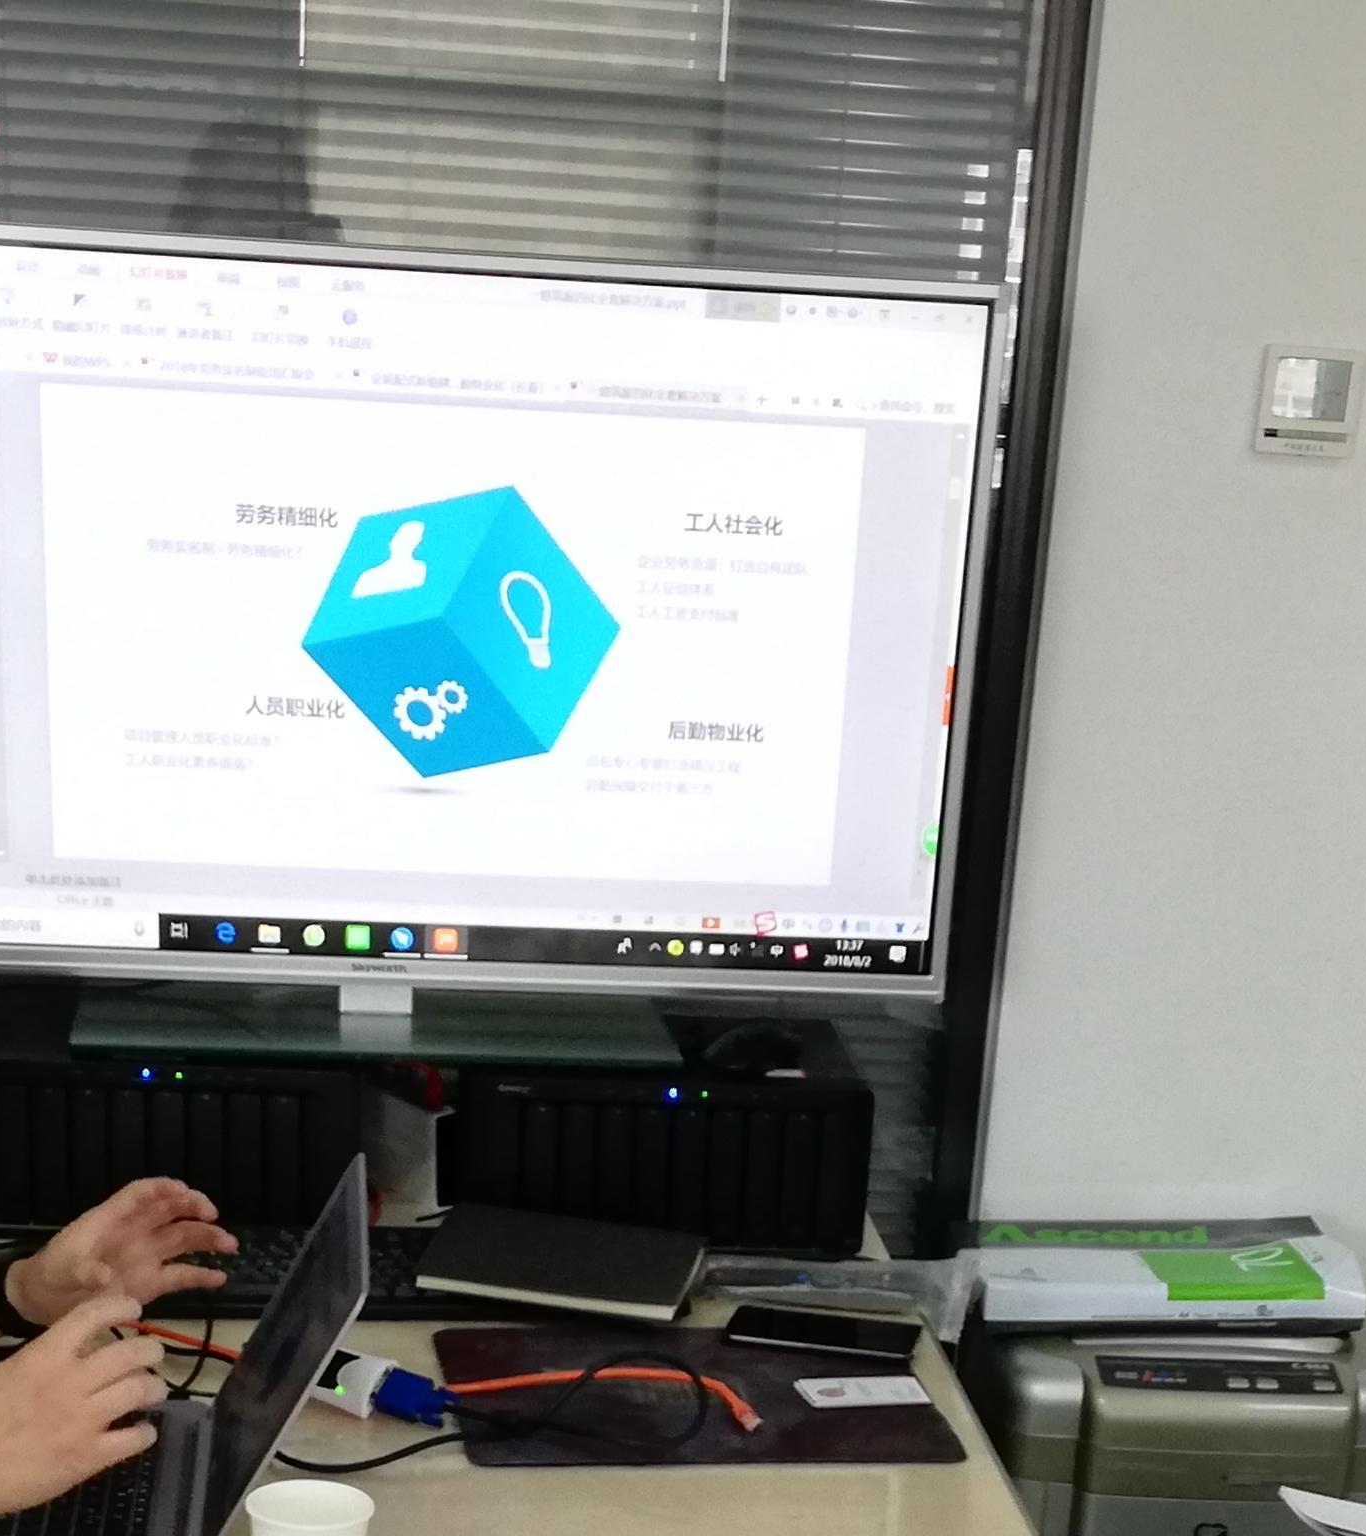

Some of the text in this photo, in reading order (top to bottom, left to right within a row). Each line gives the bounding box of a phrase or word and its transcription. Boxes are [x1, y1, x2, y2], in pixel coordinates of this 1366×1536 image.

[235, 503, 339, 529] 劳务精细化
[684, 512, 784, 537] 工人社会化
[245, 694, 346, 720] 人员职业化
[667, 720, 765, 744] 后勤物业化
